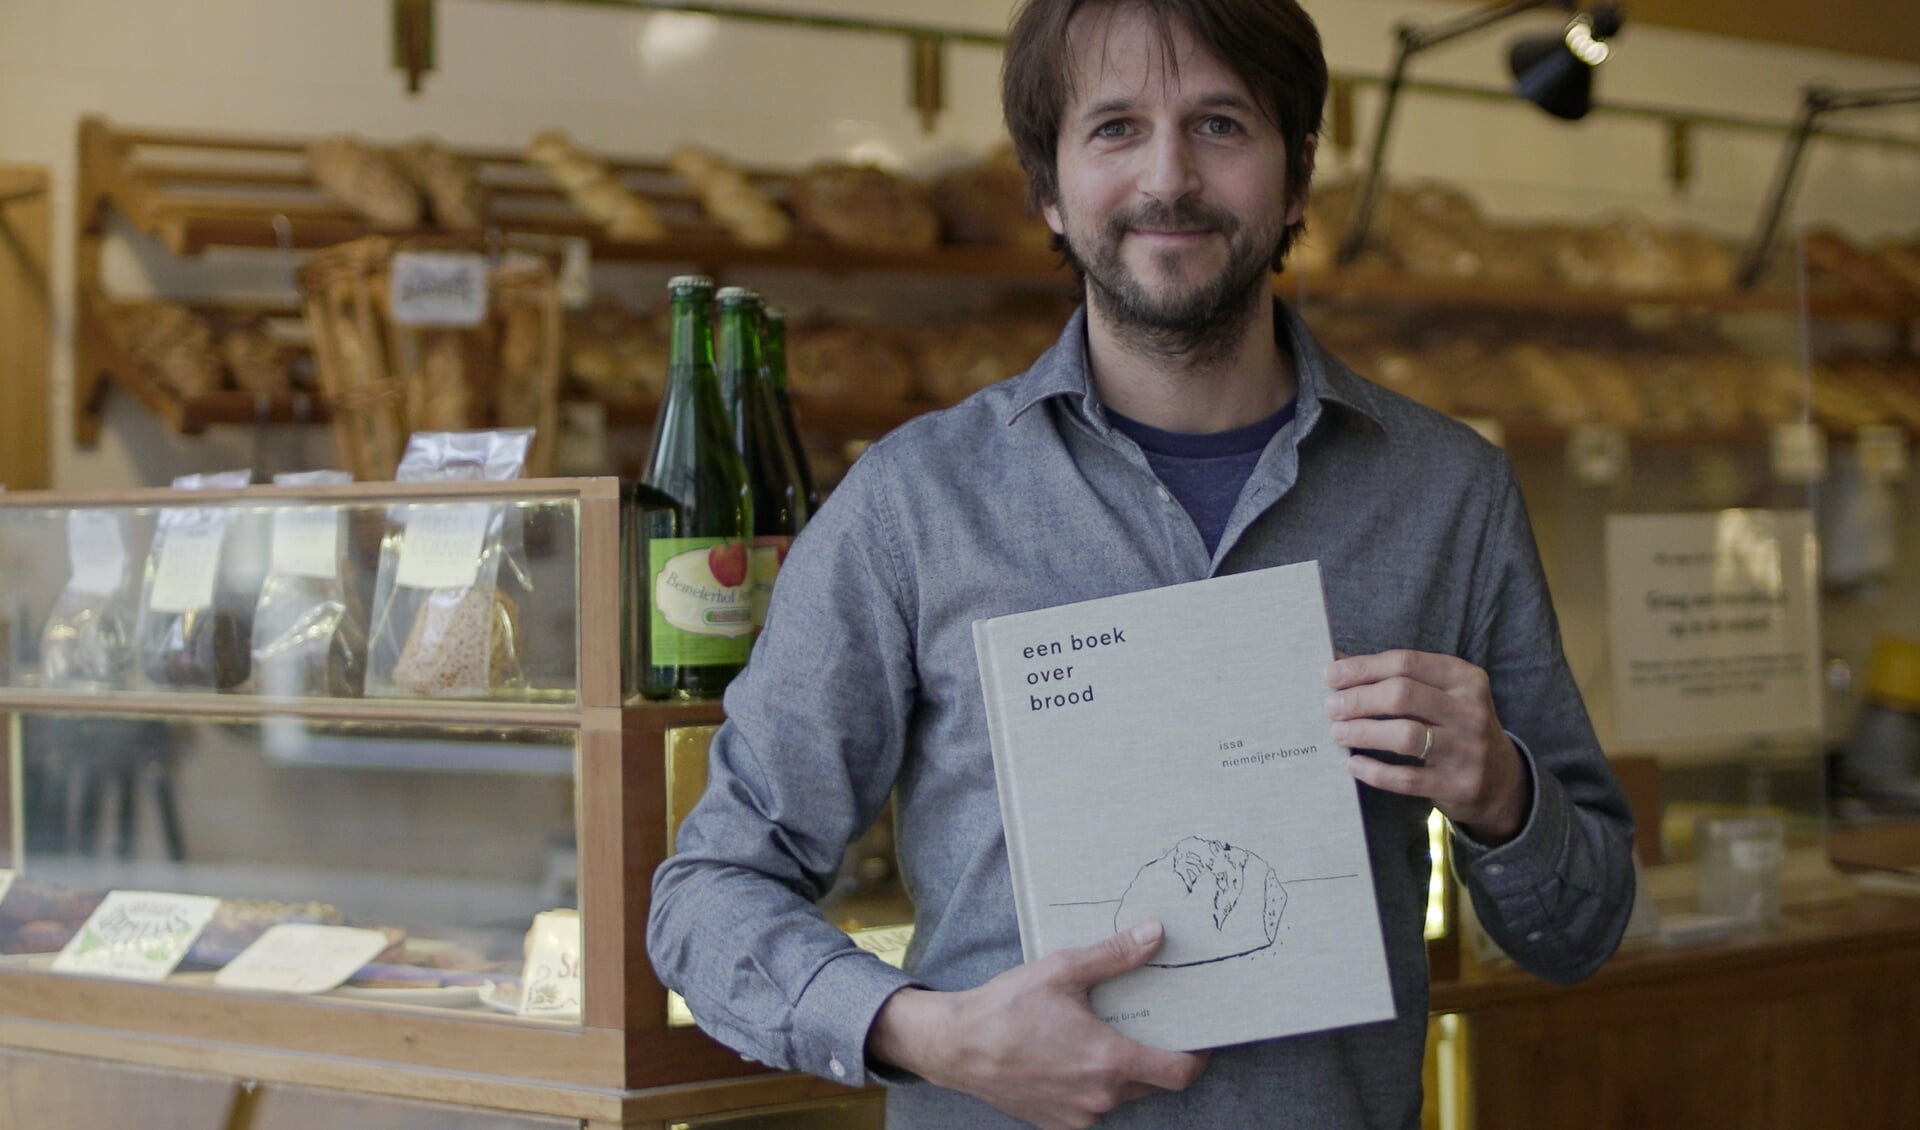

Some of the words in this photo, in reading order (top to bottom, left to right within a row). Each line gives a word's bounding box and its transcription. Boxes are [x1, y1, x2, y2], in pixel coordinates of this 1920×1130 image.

[1023, 641, 1062, 659] een
[1070, 626, 1126, 651] boek
[1026, 665, 1074, 685] over
[1029, 684, 1094, 711] brood
[1218, 739, 1244, 751] issa
[1221, 744, 1318, 768] niemeijer-brown
[1121, 1009, 1150, 1021] brandt
